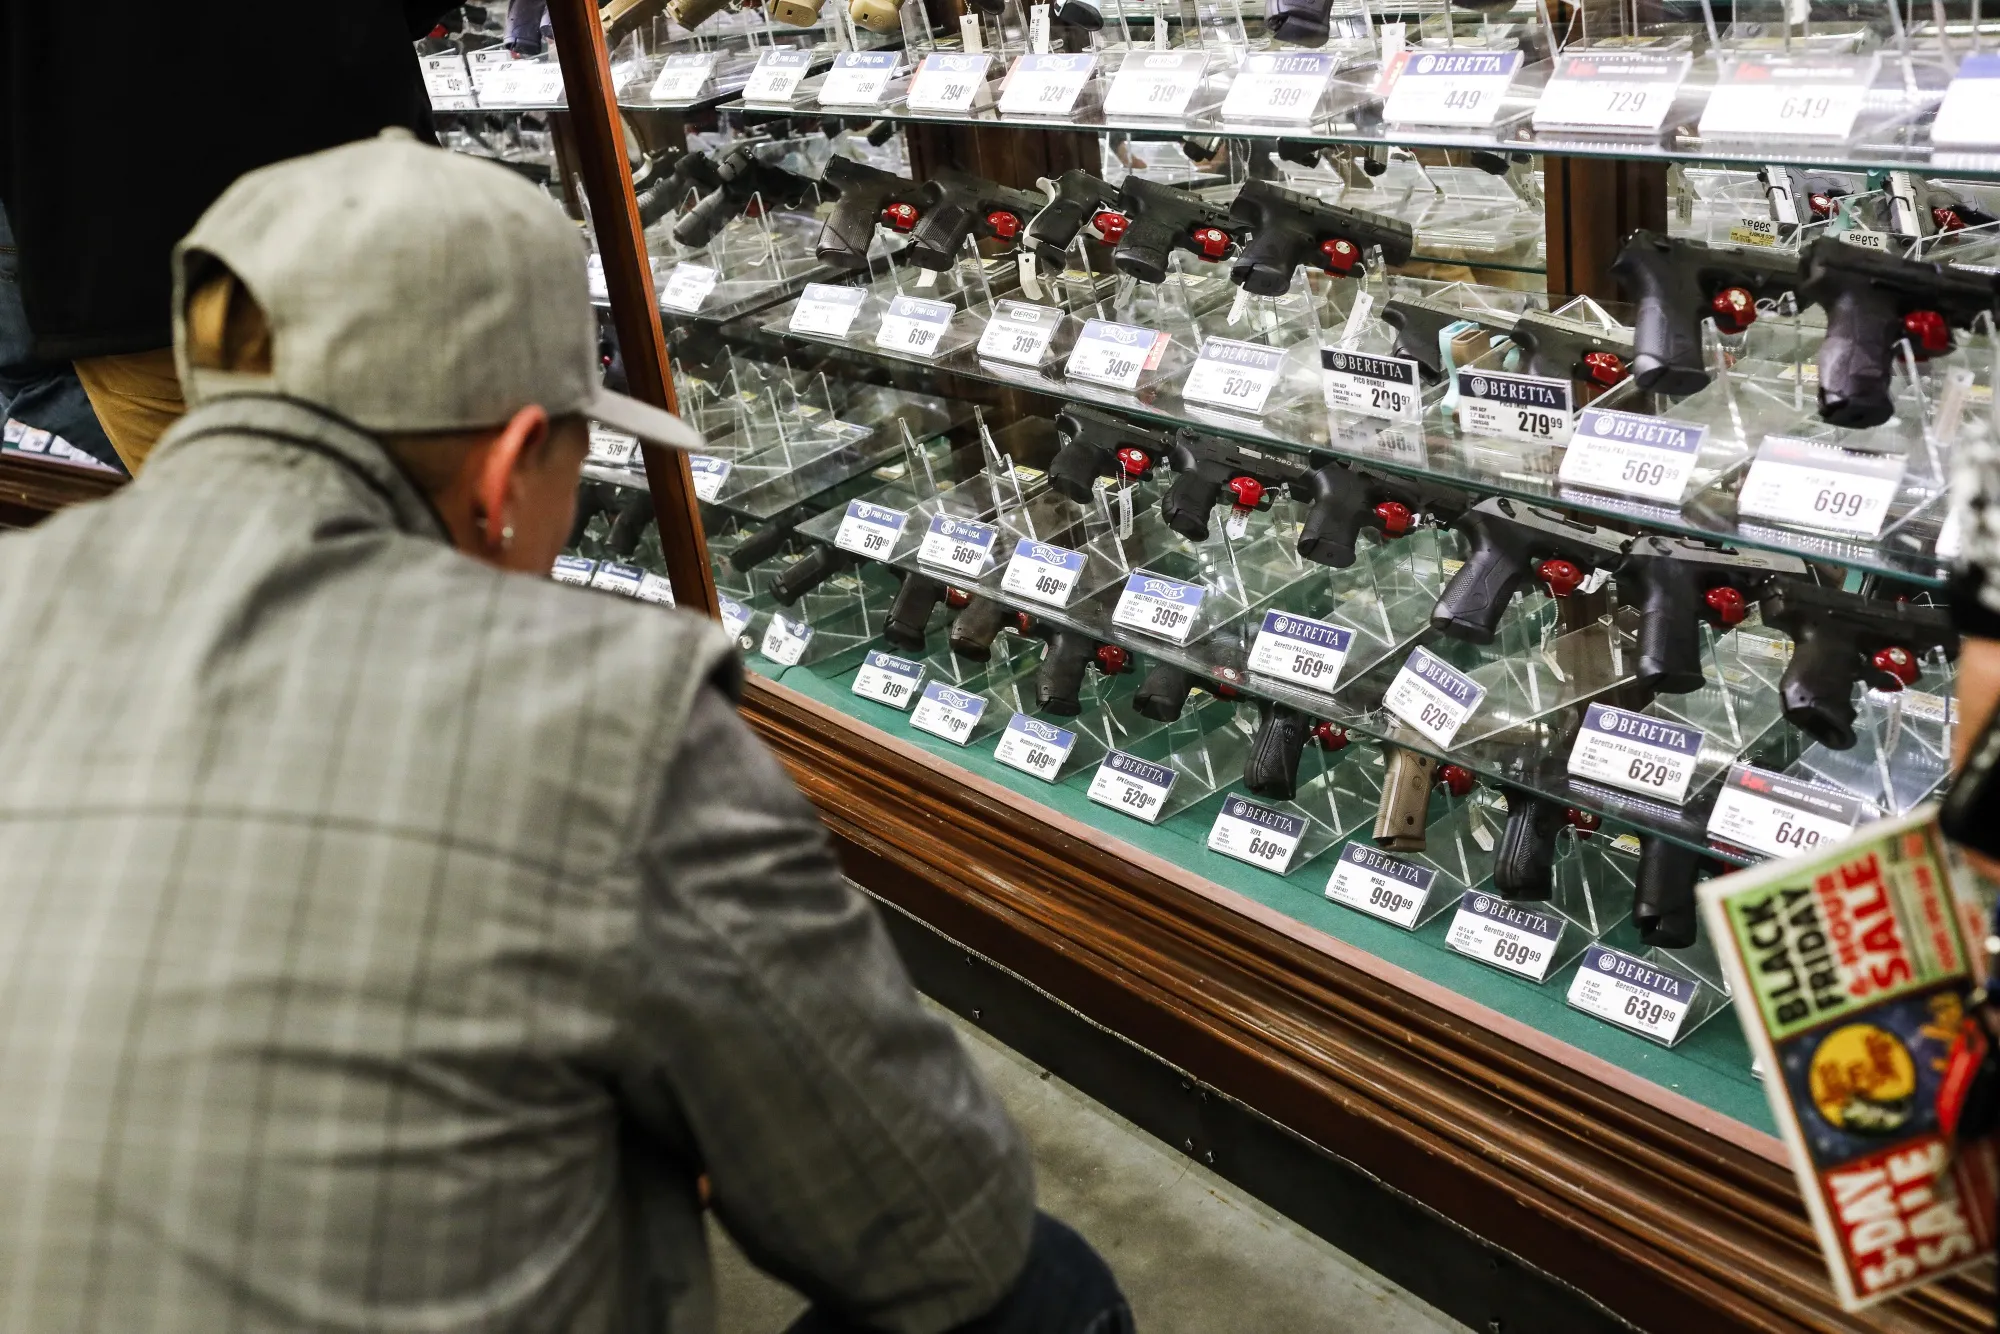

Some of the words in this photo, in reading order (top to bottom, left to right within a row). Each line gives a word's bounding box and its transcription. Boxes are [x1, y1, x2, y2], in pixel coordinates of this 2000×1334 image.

[1435, 57, 1501, 72] BERETTA
[926, 308, 938, 317] USA
[1013, 310, 1039, 321] BERSA
[1222, 346, 1269, 366] BERETTA
[1348, 356, 1403, 379] BERETTA
[1353, 376, 1366, 385] PICO
[1366, 378, 1386, 388] BUNDLE
[1490, 381, 1556, 404] BERETTA
[1614, 420, 1687, 447] BERETTA
[1264, 454, 1293, 466] PK380
[870, 510, 882, 519] FNH
[882, 512, 893, 523] USA
[955, 526, 968, 536] FNH
[968, 529, 980, 540] USA
[1036, 547, 1061, 563] WALTHER
[1149, 580, 1178, 597] WALTHER
[1288, 621, 1339, 646] BERETTA
[1274, 640, 1292, 651] Beretta
[1301, 647, 1326, 660] Compact
[888, 660, 900, 668] FNH
[900, 663, 911, 672] USA
[1405, 678, 1421, 692] Beretta
[1426, 664, 1469, 701] BERETTA
[1618, 717, 1687, 749] BERETTA
[1589, 736, 1614, 749] Beretta
[1667, 757, 1681, 768] Size
[1123, 759, 1164, 783] BERETTA
[1246, 806, 1292, 832] BERETTA
[1249, 828, 1262, 837] 92FS
[1367, 853, 1419, 882] BERETTA
[1370, 876, 1386, 887] M9A3
[1490, 902, 1548, 933] BERETTA
[1841, 852, 1914, 989] SALE
[1483, 924, 1505, 937] Beretta
[1779, 885, 1846, 1011] FRIDAY
[1739, 893, 1811, 1026] BLACK
[1615, 981, 1639, 995] Beretta
[1616, 961, 1679, 996] BERETTA
[1887, 1142, 1975, 1266] SALE
